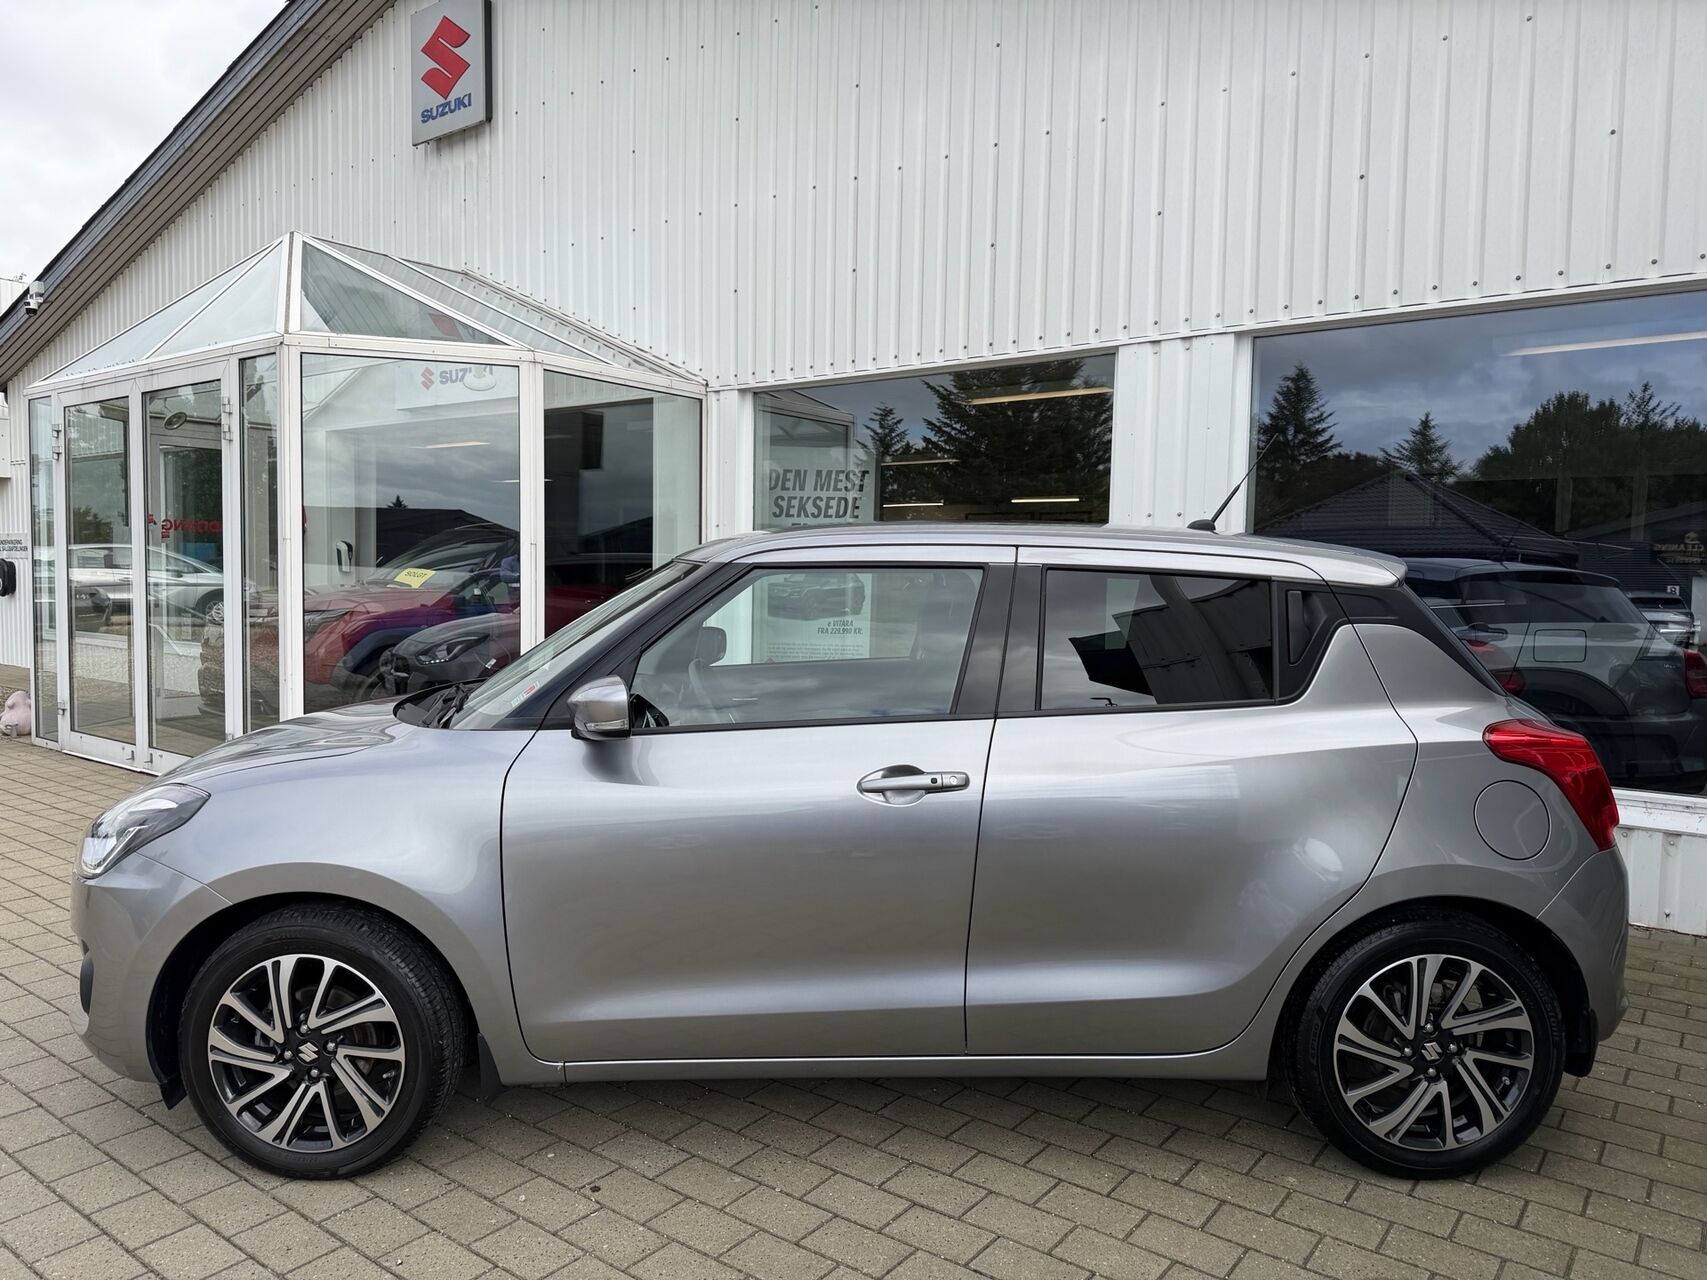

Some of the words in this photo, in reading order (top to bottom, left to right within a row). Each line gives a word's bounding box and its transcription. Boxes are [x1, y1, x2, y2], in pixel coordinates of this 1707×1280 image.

[421, 92, 472, 124] SUZUKI
[438, 365, 494, 385] SUZI
[769, 469, 808, 491] DEN
[813, 469, 870, 492] MEST
[772, 495, 862, 519] SEKSEDE
